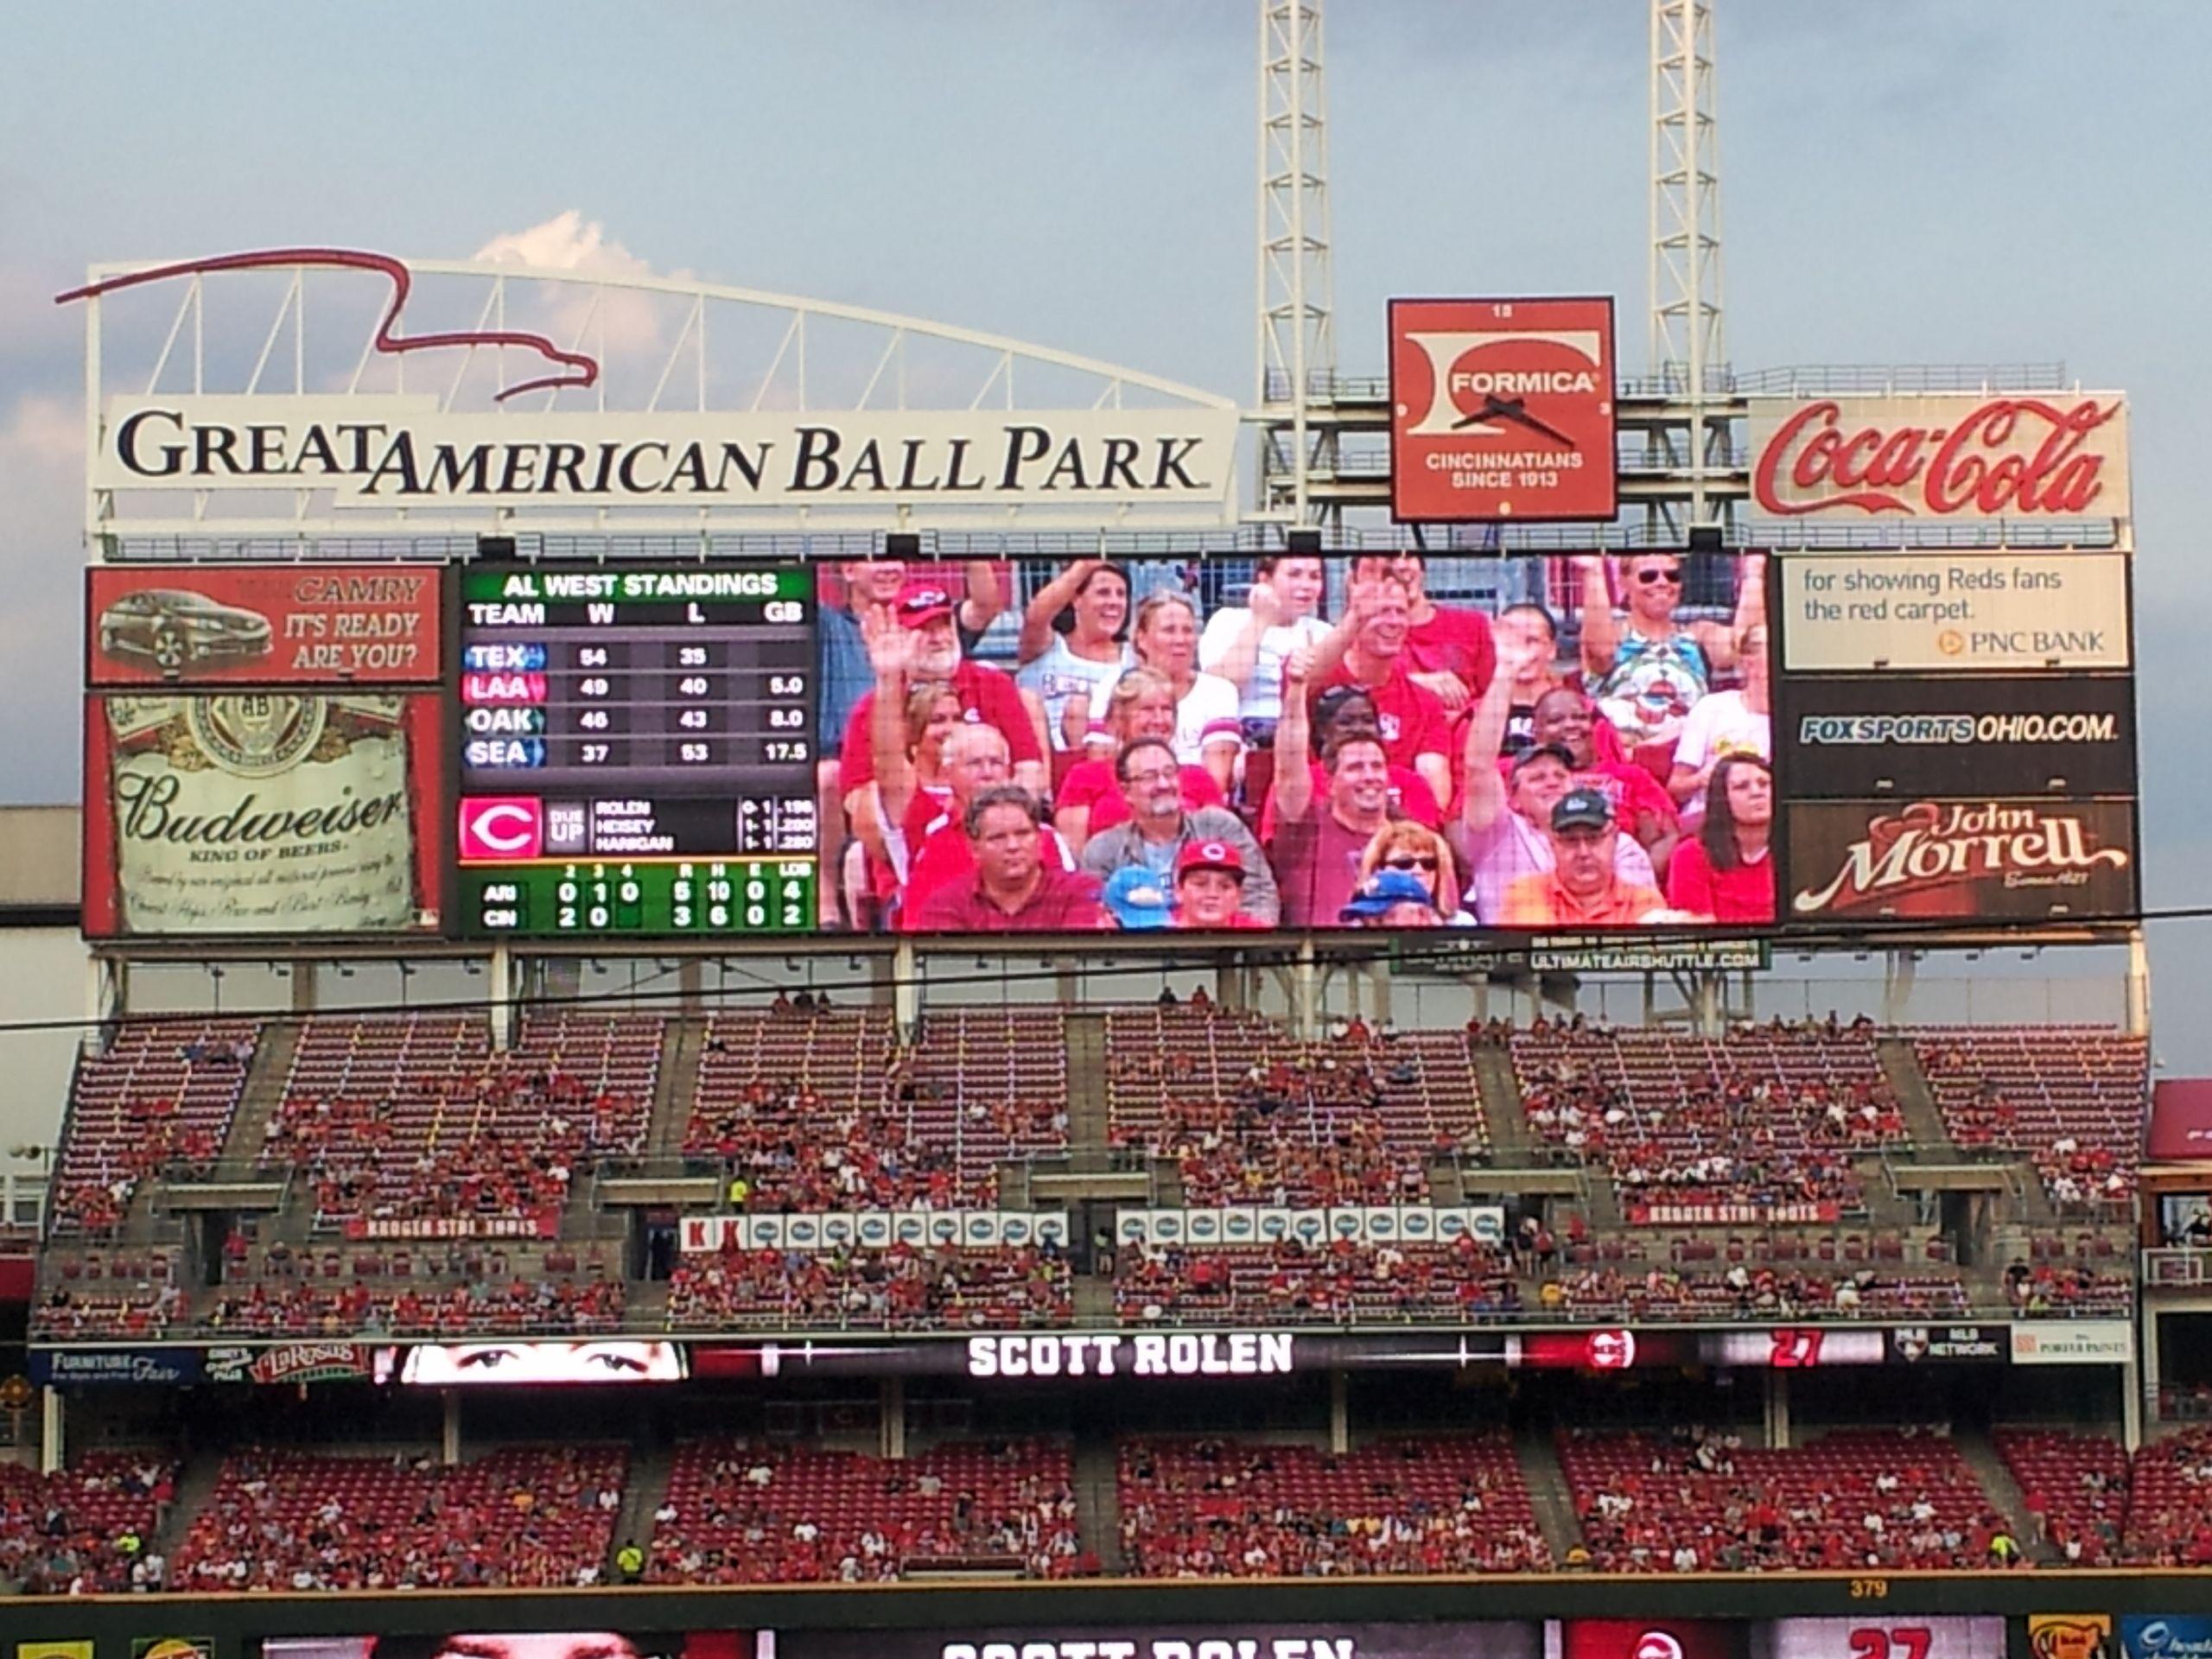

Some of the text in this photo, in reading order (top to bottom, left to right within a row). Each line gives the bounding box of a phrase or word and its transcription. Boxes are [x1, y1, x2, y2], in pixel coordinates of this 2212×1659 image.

[1452, 372, 1595, 393] FORMICA
[117, 410, 1211, 494] GREAT AMERICAN BALL PARK
[1426, 453, 1583, 469] CINCINNATIANS
[1755, 399, 2123, 515] Coca-Cola
[1452, 472, 1558, 488] SINCE 1913
[296, 576, 426, 604] CAMRY
[503, 574, 778, 596] AL WEST STANDINGS
[1804, 567, 2063, 596] for showing Reds fans
[468, 602, 804, 624] TEAM W L GB
[1804, 598, 1975, 625] the red carpet.
[284, 613, 420, 638] IT'S READY
[1971, 631, 2106, 653] PNC BANK
[292, 645, 418, 669] ARE YOU?
[472, 646, 707, 667] TEX 54 35
[472, 677, 804, 698] LAA 49 40 5.0
[471, 709, 532, 731] OAK
[680, 710, 708, 728] 43
[469, 742, 808, 763] SEA 37 53 17.5
[118, 772, 404, 843] Budweiser
[1932, 803, 2034, 836] John
[550, 823, 585, 842] UP
[188, 841, 340, 864] KING OF BEERS
[621, 865, 633, 877] 4
[1794, 818, 2128, 912] Morrell
[558, 883, 577, 902] 0
[594, 883, 607, 902] 1
[620, 882, 639, 902] 0
[747, 881, 765, 900] 0
[783, 880, 802, 899] 4
[483, 911, 518, 927] CIN
[559, 908, 577, 927] 2
[589, 907, 608, 927] 0
[674, 906, 691, 926] 3
[747, 906, 766, 925] 0
[783, 906, 801, 925] 2
[688, 1222, 705, 1246] K
[723, 1220, 739, 1246] K
[969, 1333, 1294, 1376] SCOTT ROLEN
[1770, 1329, 1825, 1368] 27
[52, 1352, 131, 1370] FURNITURE
[1850, 1580, 1889, 1598] 379
